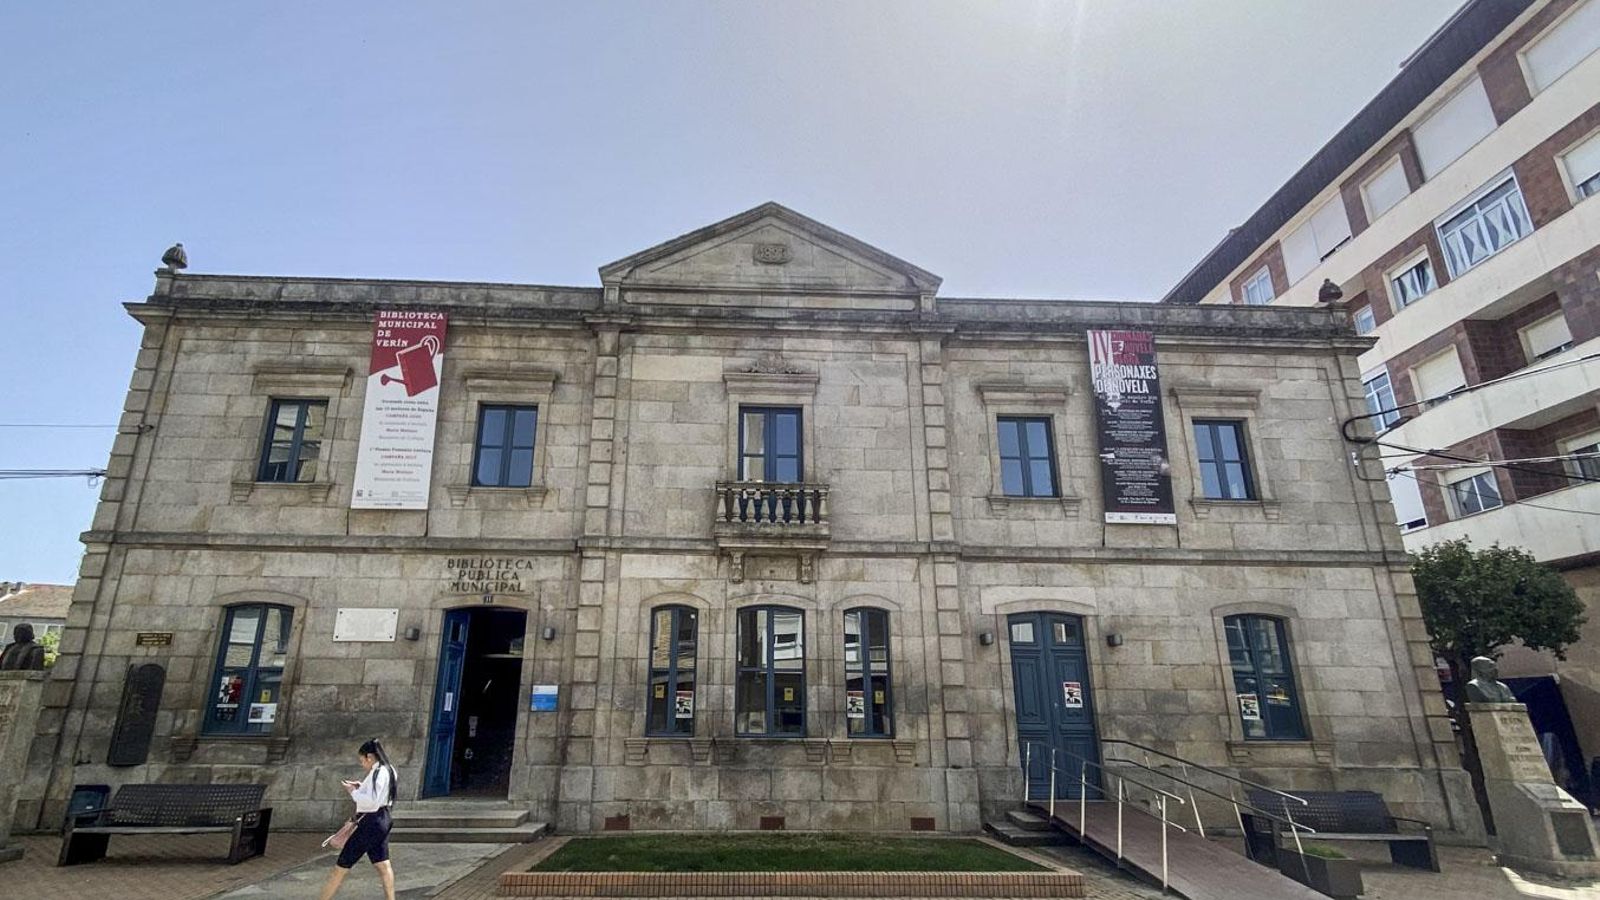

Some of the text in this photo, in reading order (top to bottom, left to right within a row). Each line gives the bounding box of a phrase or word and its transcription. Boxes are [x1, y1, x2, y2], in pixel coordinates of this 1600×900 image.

[380, 311, 444, 320] BIBLIOTECA
[378, 320, 437, 329] MUNICIPAL
[376, 338, 408, 347] VERÍN
[1111, 380, 1150, 394] NOVELA
[447, 559, 533, 569] BIBLIOTECA
[458, 570, 519, 580] PUBLICA
[451, 582, 525, 592] MUNICIPAL
